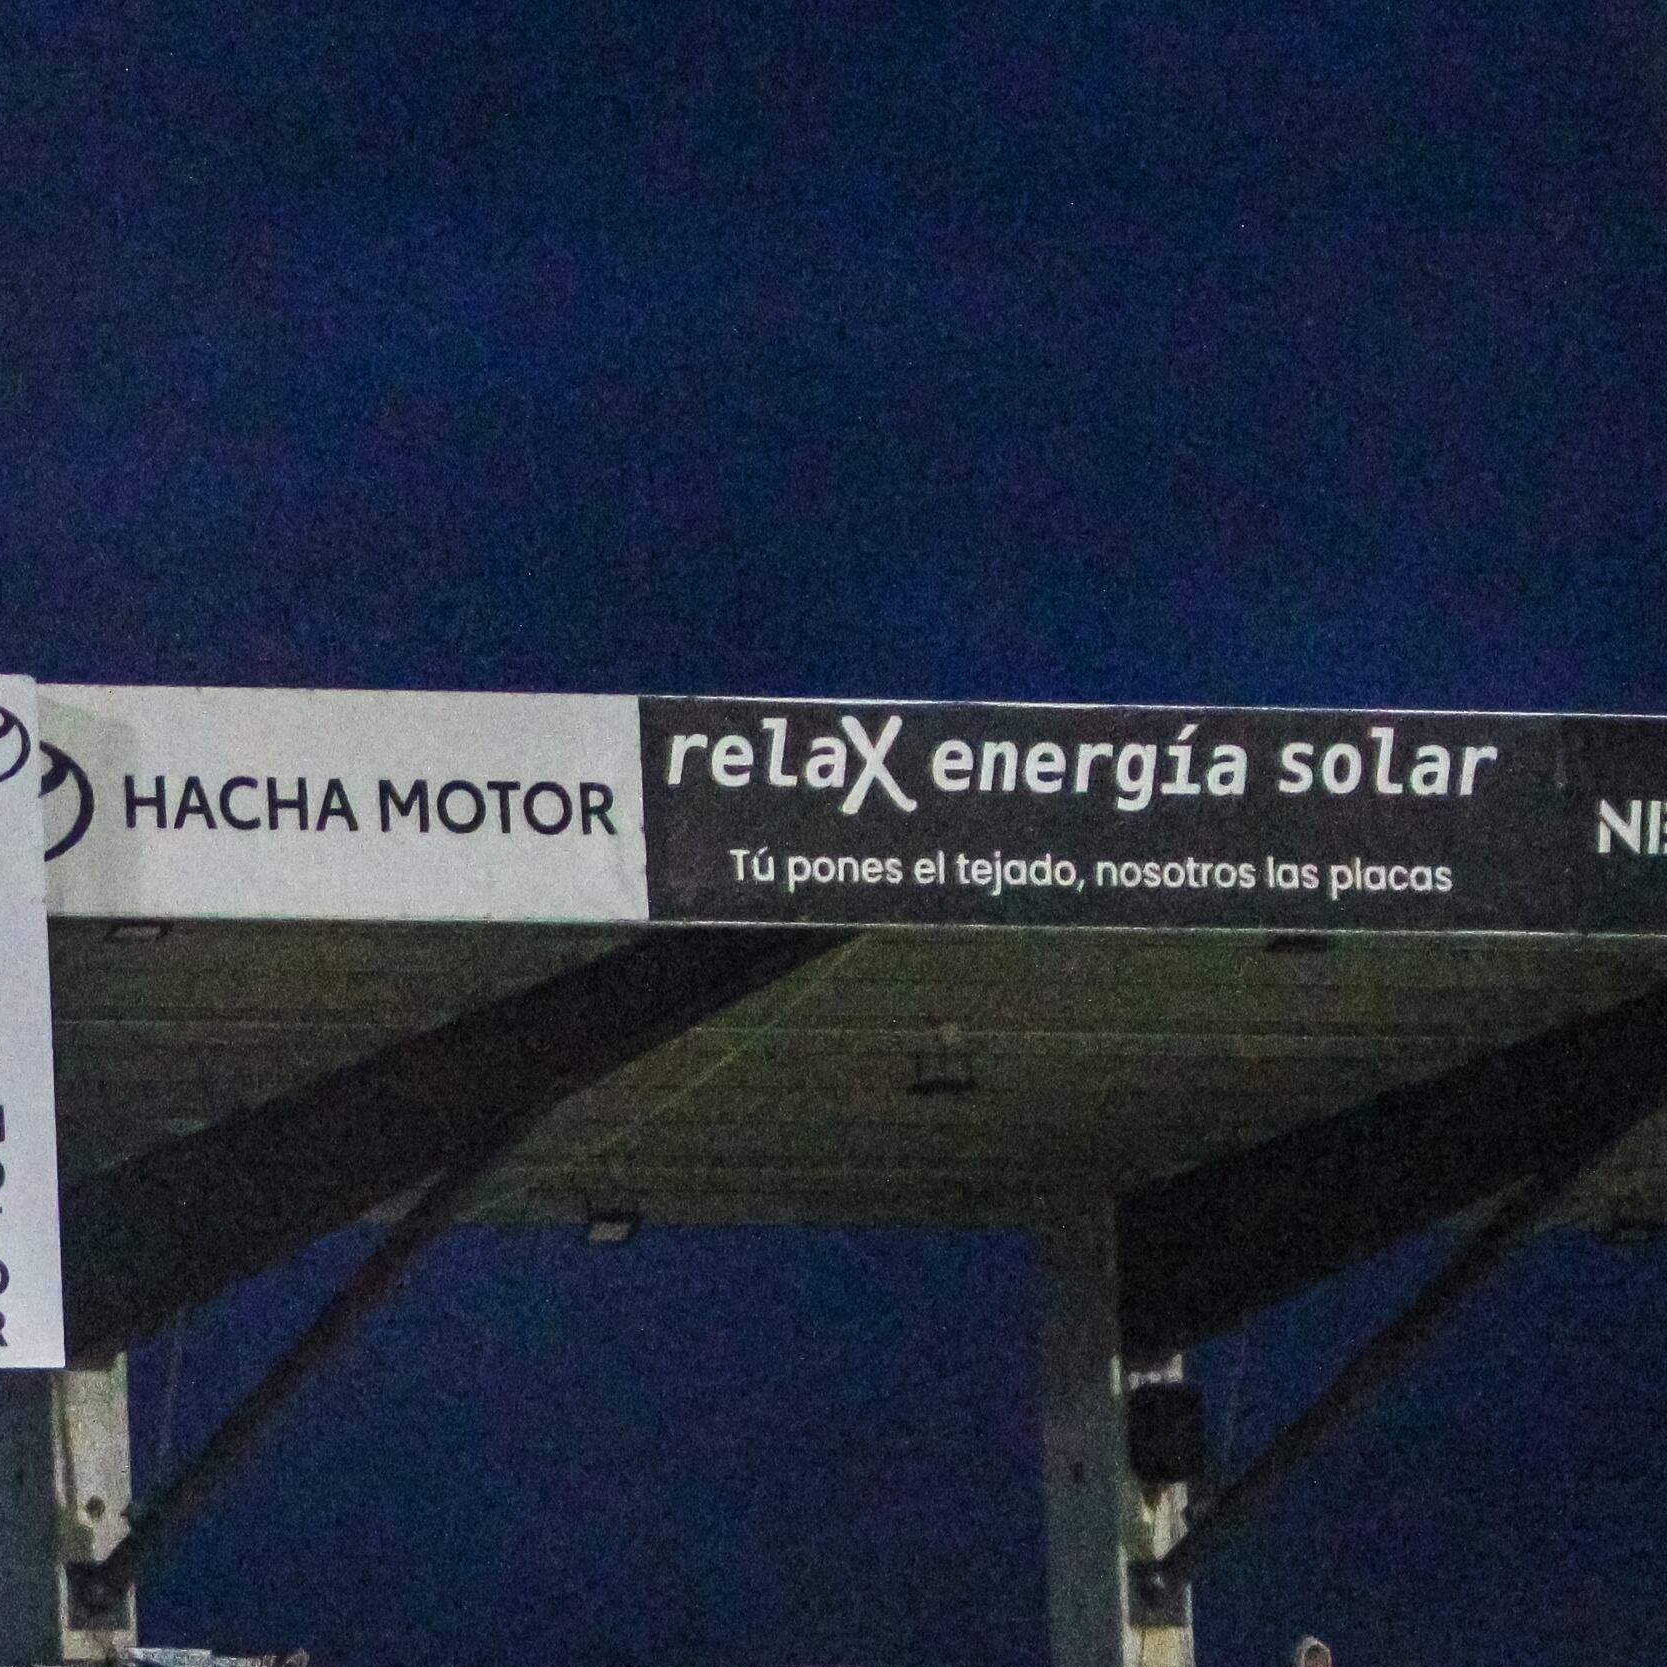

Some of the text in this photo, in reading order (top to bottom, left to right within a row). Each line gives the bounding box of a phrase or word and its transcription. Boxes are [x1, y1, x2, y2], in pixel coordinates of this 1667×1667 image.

[667, 715, 1498, 814] relaX energía solar
[124, 774, 618, 837] HACHA MOTOR
[729, 847, 1454, 901] Tú pones el tejado, nosotros las placas
